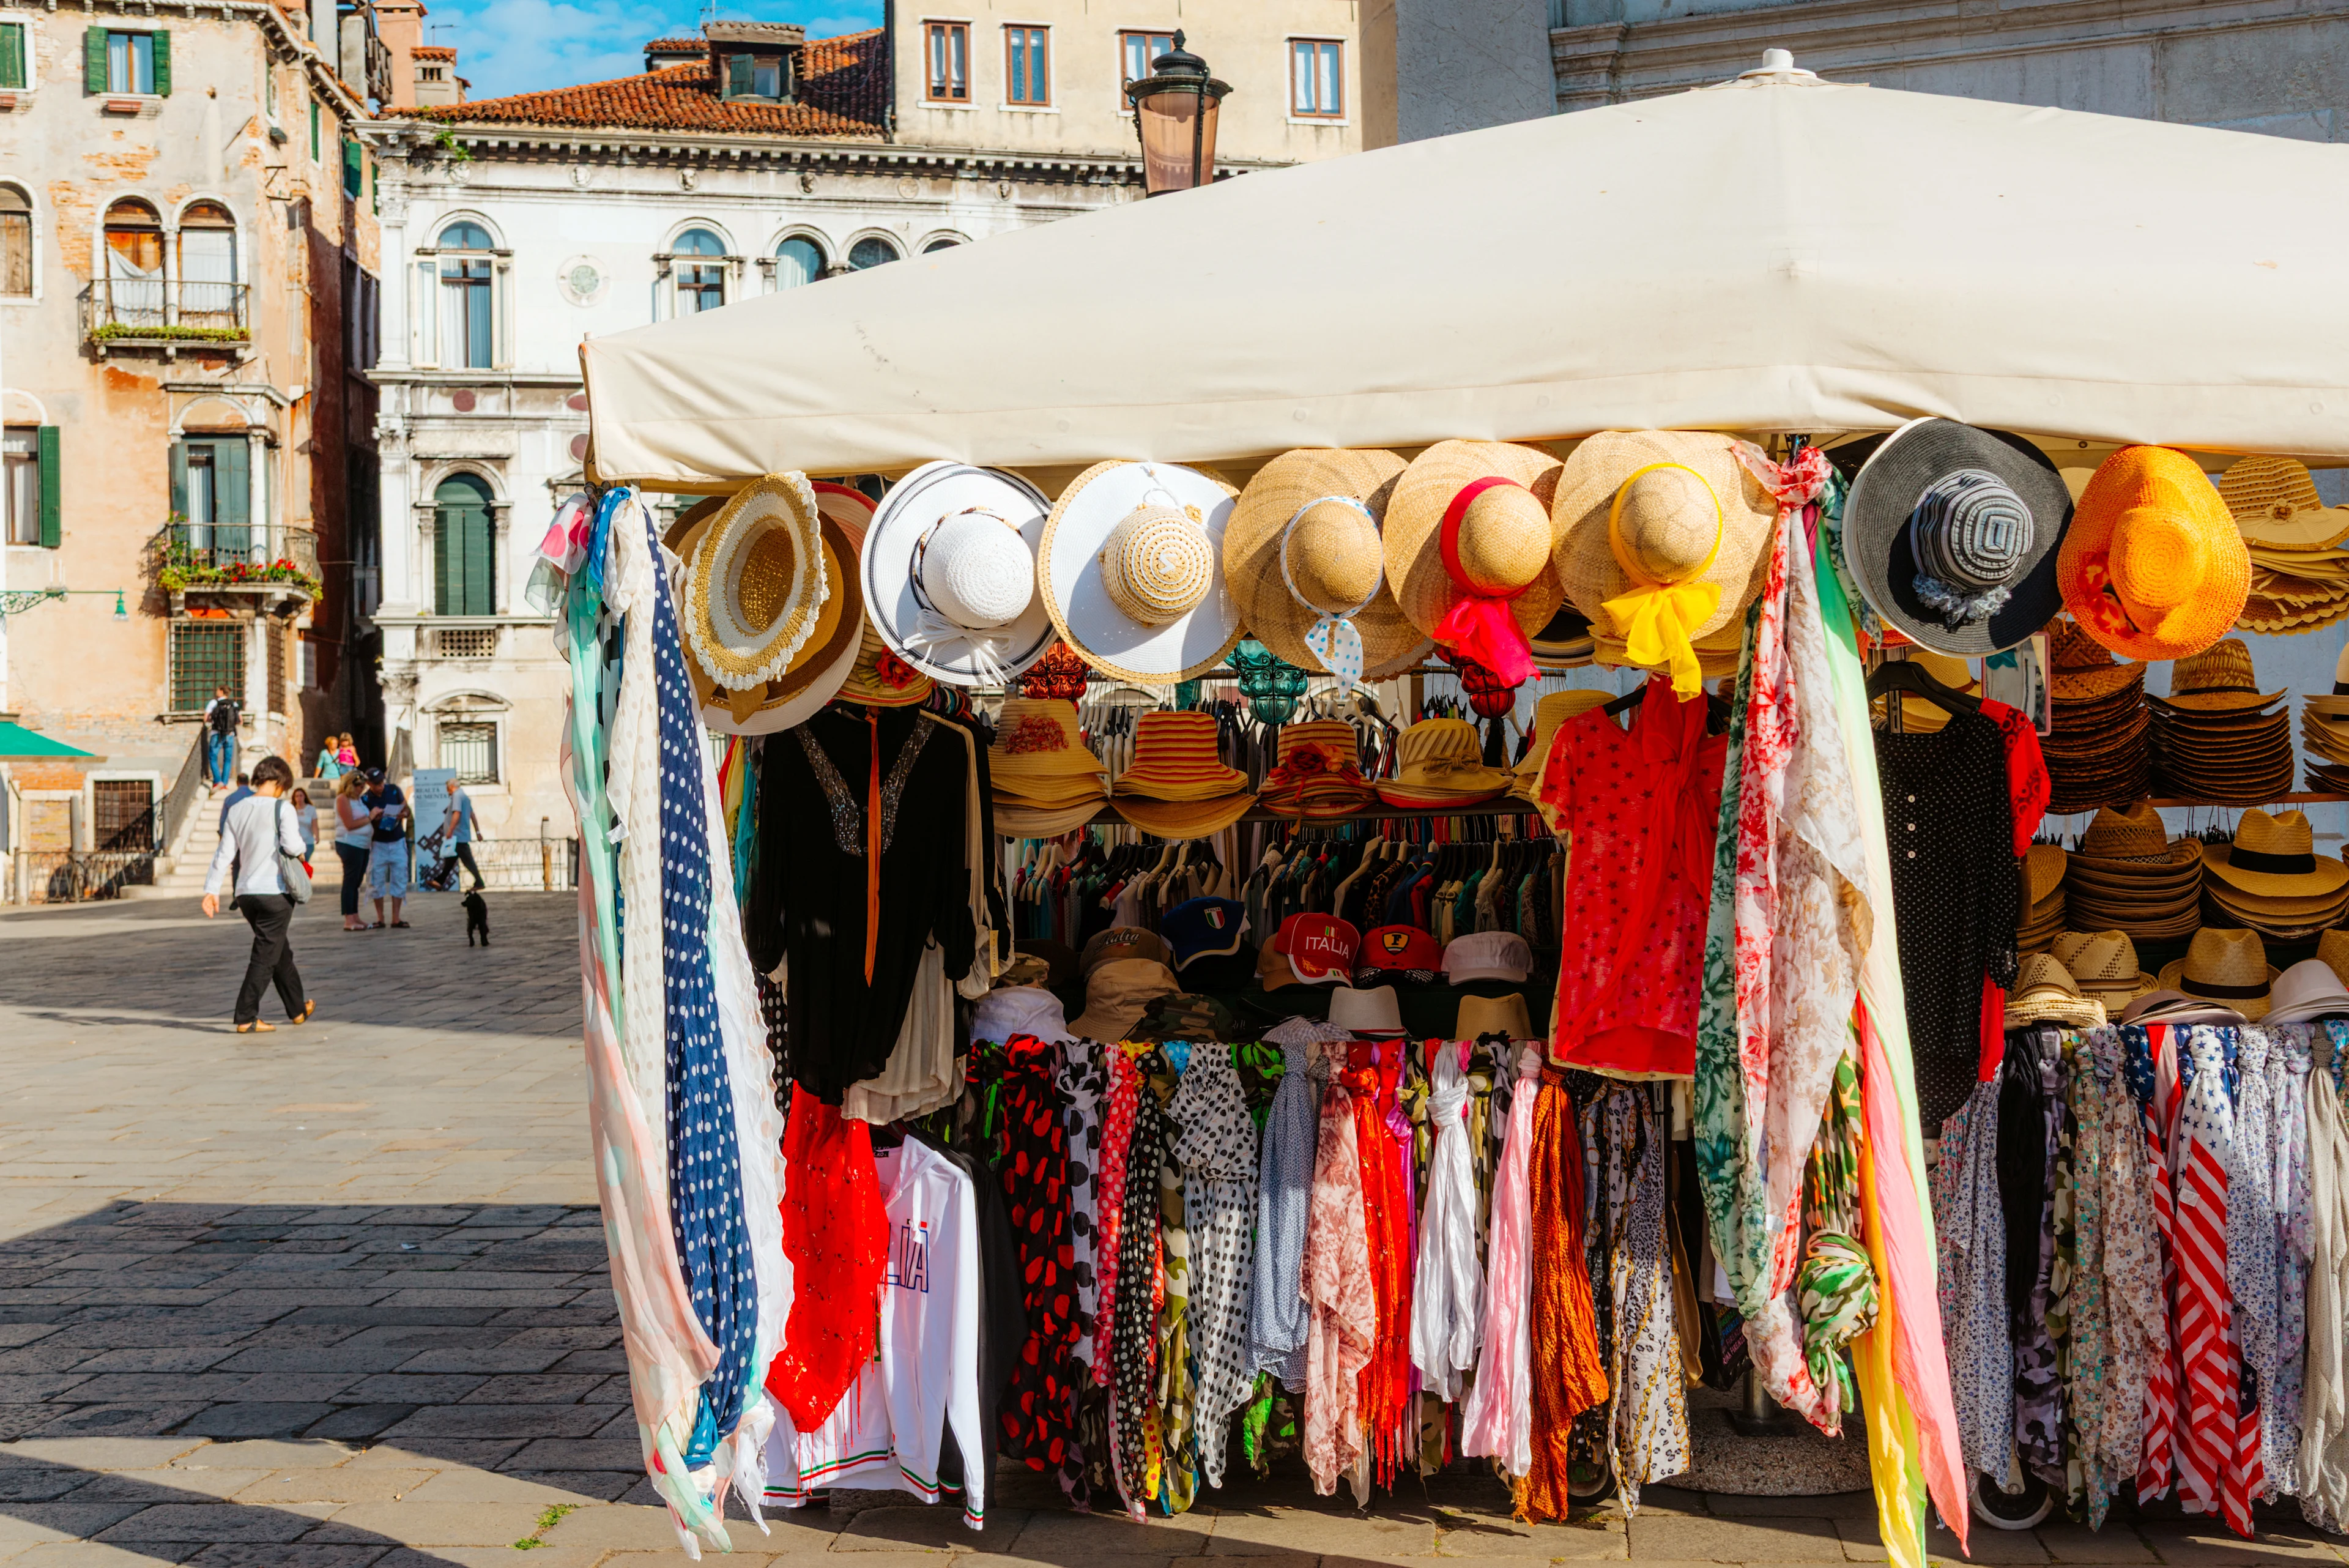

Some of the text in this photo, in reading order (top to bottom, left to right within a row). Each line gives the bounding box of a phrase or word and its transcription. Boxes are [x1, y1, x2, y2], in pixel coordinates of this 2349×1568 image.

[1095, 928, 1140, 950] Italia
[1305, 936, 1349, 959] ITALIA
[1391, 934, 1402, 945] F
[1722, 1317, 1739, 1337] FIRENZE
[1726, 1326, 1742, 1346] FIRENZE
[1729, 1334, 1746, 1355] FIRENZE
